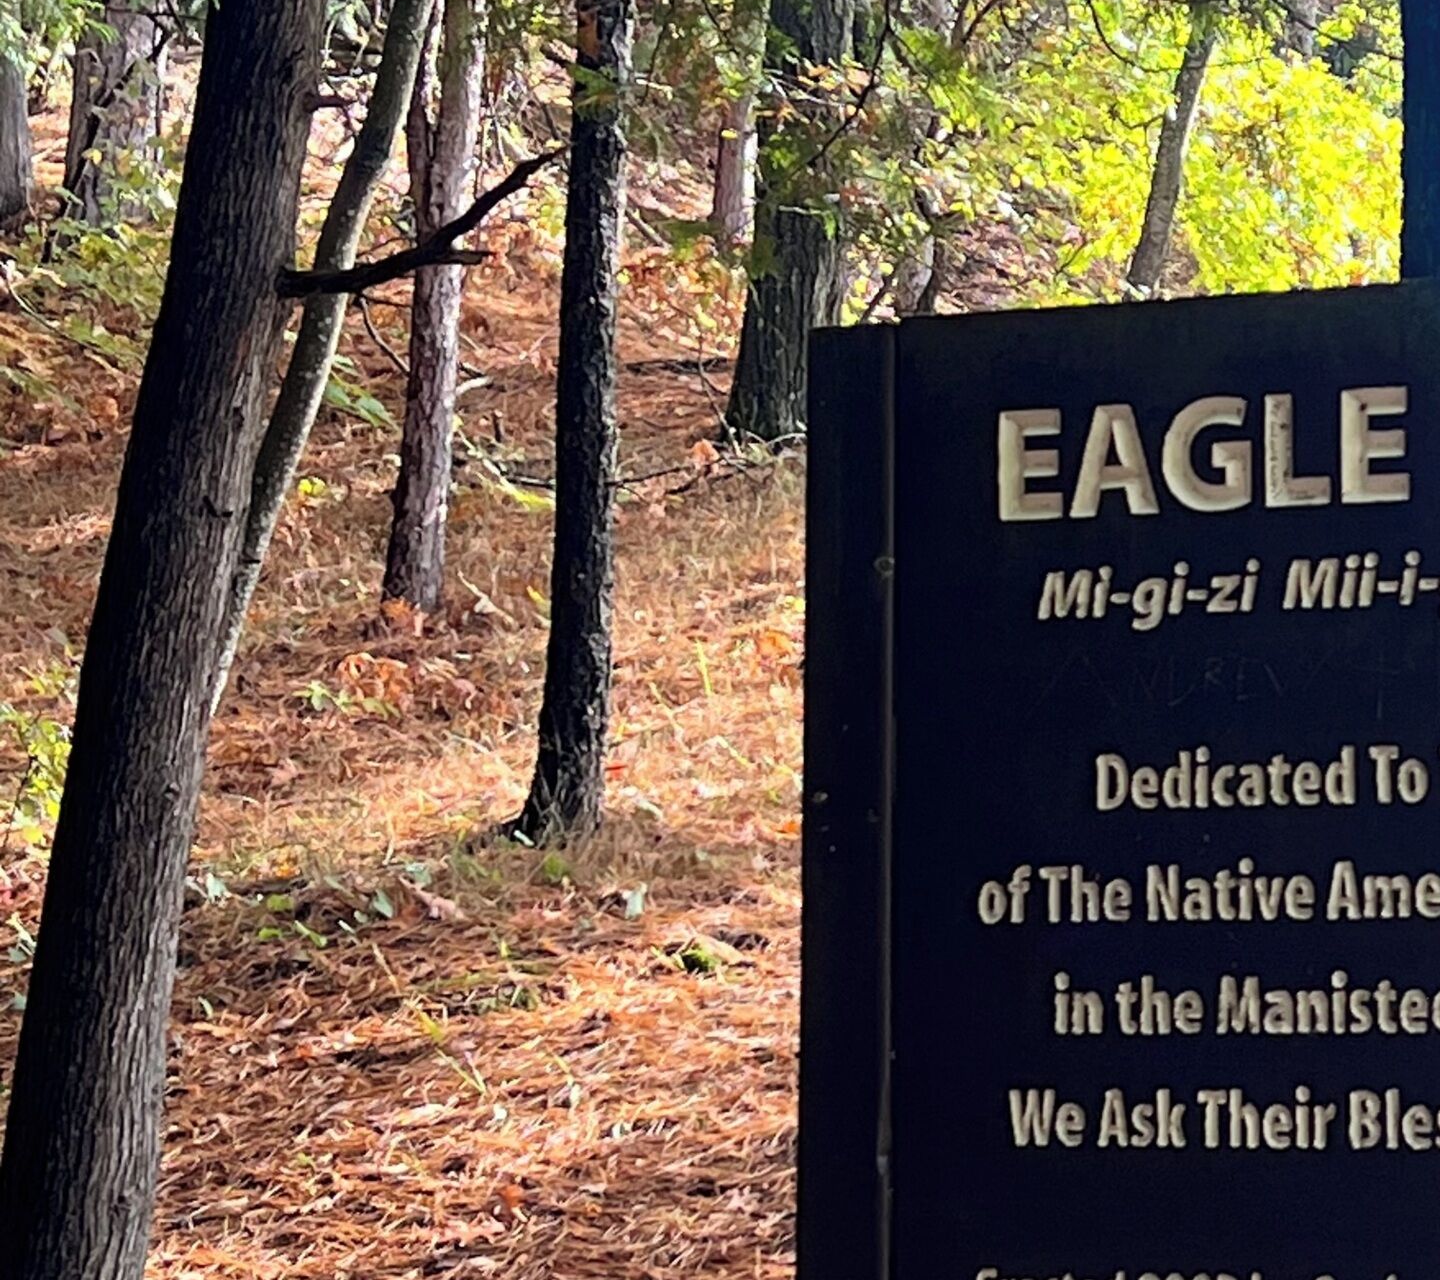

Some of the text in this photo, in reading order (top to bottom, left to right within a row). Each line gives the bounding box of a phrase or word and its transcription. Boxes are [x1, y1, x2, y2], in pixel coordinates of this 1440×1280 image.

[997, 386, 1410, 522] EAGLE
[1037, 558, 1259, 632] Mi-gi-zi
[1094, 745, 1356, 811] Dedicated
[1368, 745, 1428, 804] To
[977, 864, 1032, 925] of
[1038, 864, 1131, 924] The
[1145, 857, 1315, 922] Native
[1053, 971, 1104, 1036] in
[1114, 974, 1204, 1036] the
[1008, 1088, 1085, 1148] We
[1096, 1088, 1187, 1149] Ask
[1195, 1084, 1336, 1151] Their
